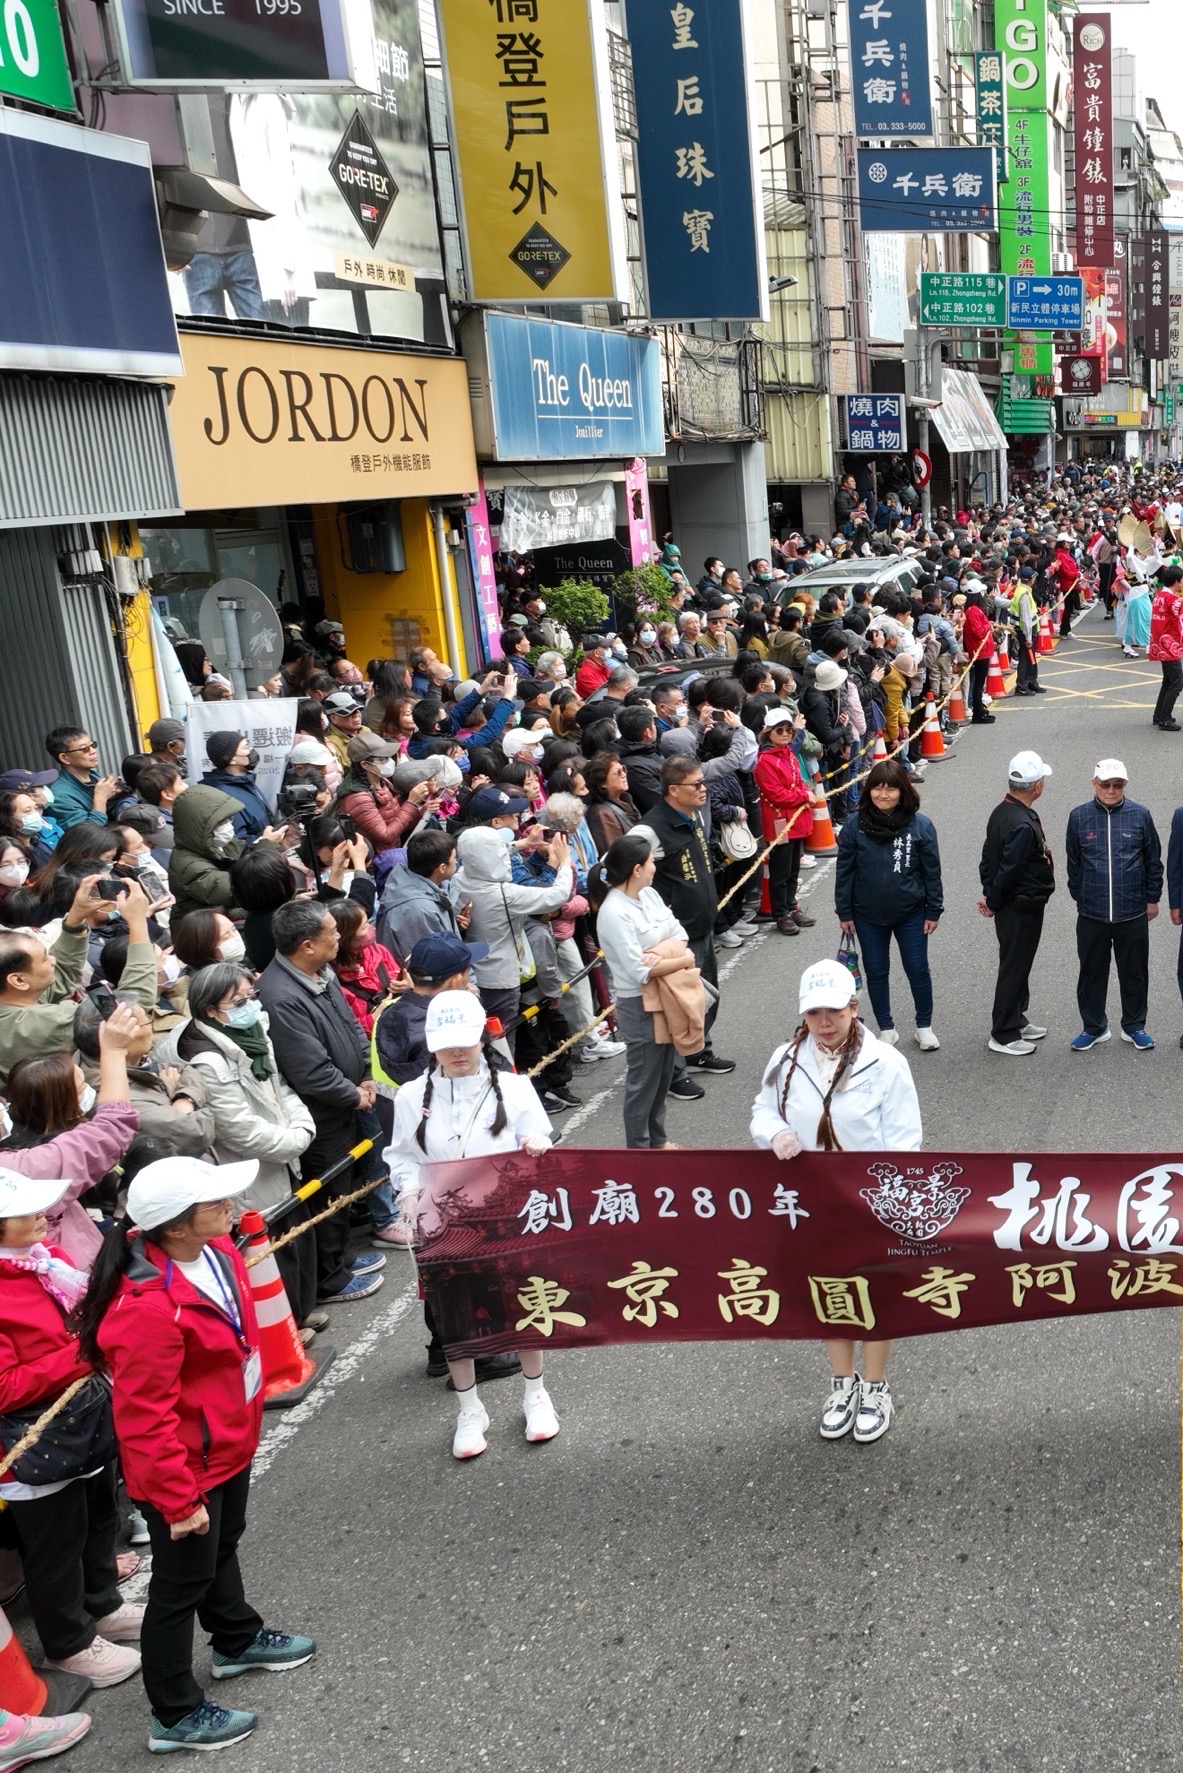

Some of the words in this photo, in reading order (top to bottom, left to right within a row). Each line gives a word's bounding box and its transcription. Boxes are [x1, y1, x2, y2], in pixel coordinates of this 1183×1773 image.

[254, 0, 303, 15] 1995
[859, 0, 897, 104] 千兵衛
[669, 2, 715, 253] 皇后珠寶
[1015, 119, 1029, 130] 4F
[1082, 62, 1107, 184] 富貴鐘錶
[338, 163, 390, 195] GORE-TEX
[892, 172, 983, 198] 千兵衛
[1017, 177, 1030, 188] 3F
[517, 251, 561, 261] GORE-TEX
[1020, 245, 1032, 255] 2F
[1057, 285, 1078, 296] 30m
[1011, 302, 1081, 316] 新民立體停車場
[953, 315, 987, 324] Zhongzheng
[987, 315, 998, 323] Rd.
[1010, 316, 1032, 324] Sinmin
[1034, 316, 1059, 325] Parking
[1061, 317, 1081, 325] Tower
[533, 358, 569, 406] The
[579, 363, 633, 411] Queen
[203, 366, 429, 446] JORDON
[850, 397, 899, 417] 燒肉
[870, 419, 879, 428] &
[575, 425, 604, 439] Joaillier
[851, 430, 900, 450] 鍋物
[350, 453, 431, 473] 橋登戶外機能服飾
[555, 557, 574, 569] The
[578, 556, 614, 570] Queen
[906, 1167, 924, 1175] 1745
[517, 1180, 810, 1234] 創廟280年
[887, 1247, 919, 1257] JINGFU
